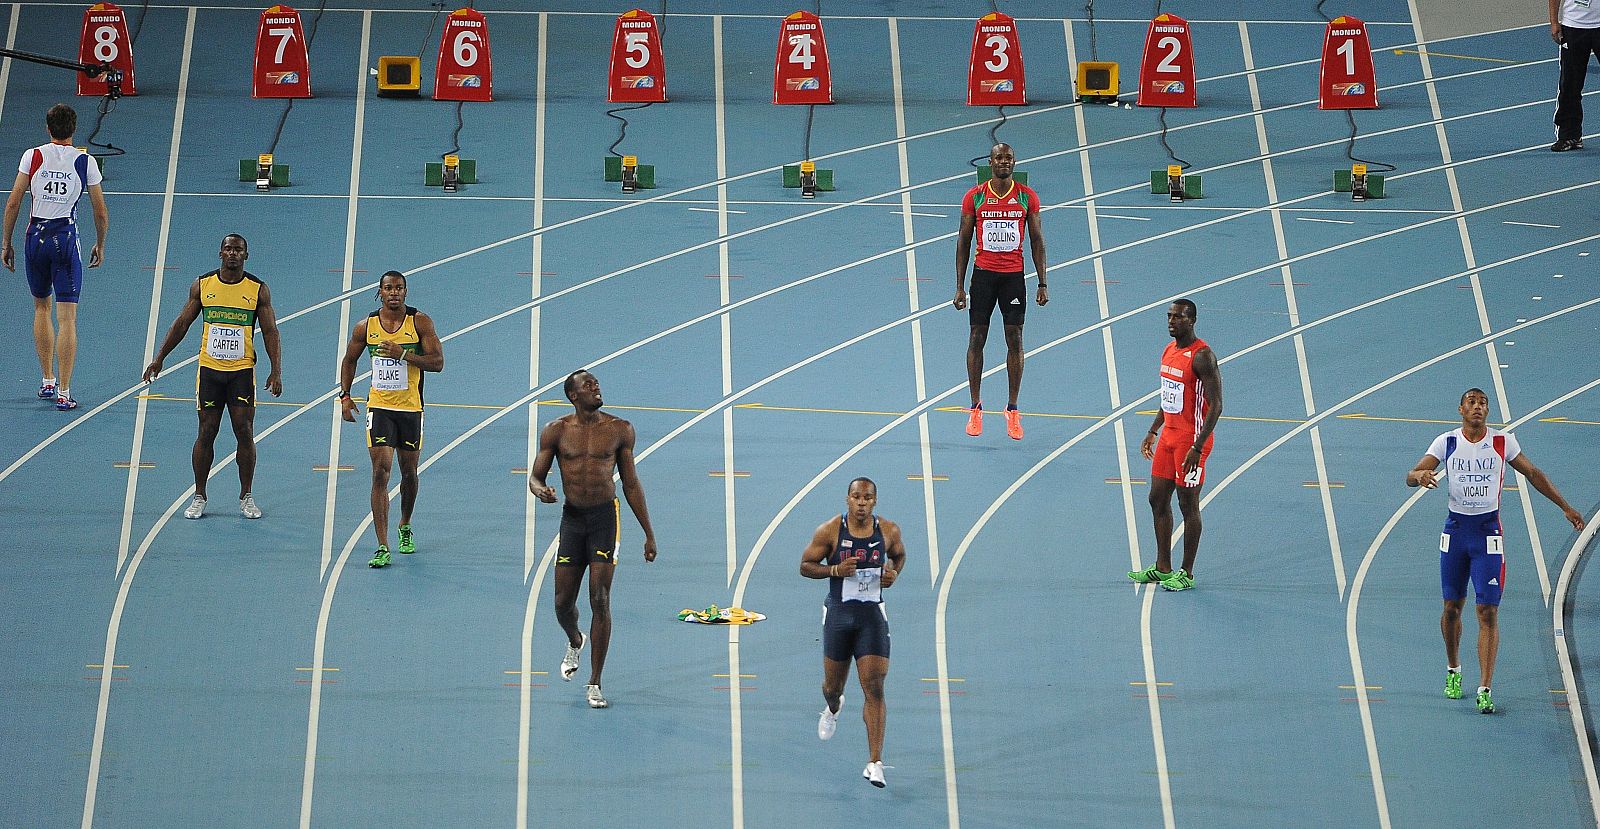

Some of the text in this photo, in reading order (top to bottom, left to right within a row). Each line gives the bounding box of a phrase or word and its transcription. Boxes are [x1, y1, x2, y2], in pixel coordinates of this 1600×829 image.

[94, 25, 118, 62] 8
[269, 28, 293, 64] 7
[453, 30, 478, 67] 6
[625, 32, 650, 68] 5
[789, 33, 816, 70] 4
[985, 35, 1009, 72] 3
[1157, 36, 1181, 72] 2
[1337, 38, 1354, 75] 1
[49, 170, 72, 180] TDK
[43, 181, 68, 195] 413
[1008, 210, 1023, 218] NEVIS
[993, 221, 1015, 229] TDK
[987, 231, 1016, 242] COLLINS
[218, 327, 241, 337] TDK
[212, 338, 239, 351] CARTER
[378, 369, 400, 381] BLAKE
[1452, 457, 1496, 472] FRANCE
[1189, 470, 1198, 482] 2
[1466, 474, 1491, 482] TDK
[1462, 485, 1489, 498] VICAUT
[1493, 538, 1498, 551] 1
[840, 548, 880, 563] USA
[857, 581, 869, 592] DIX
